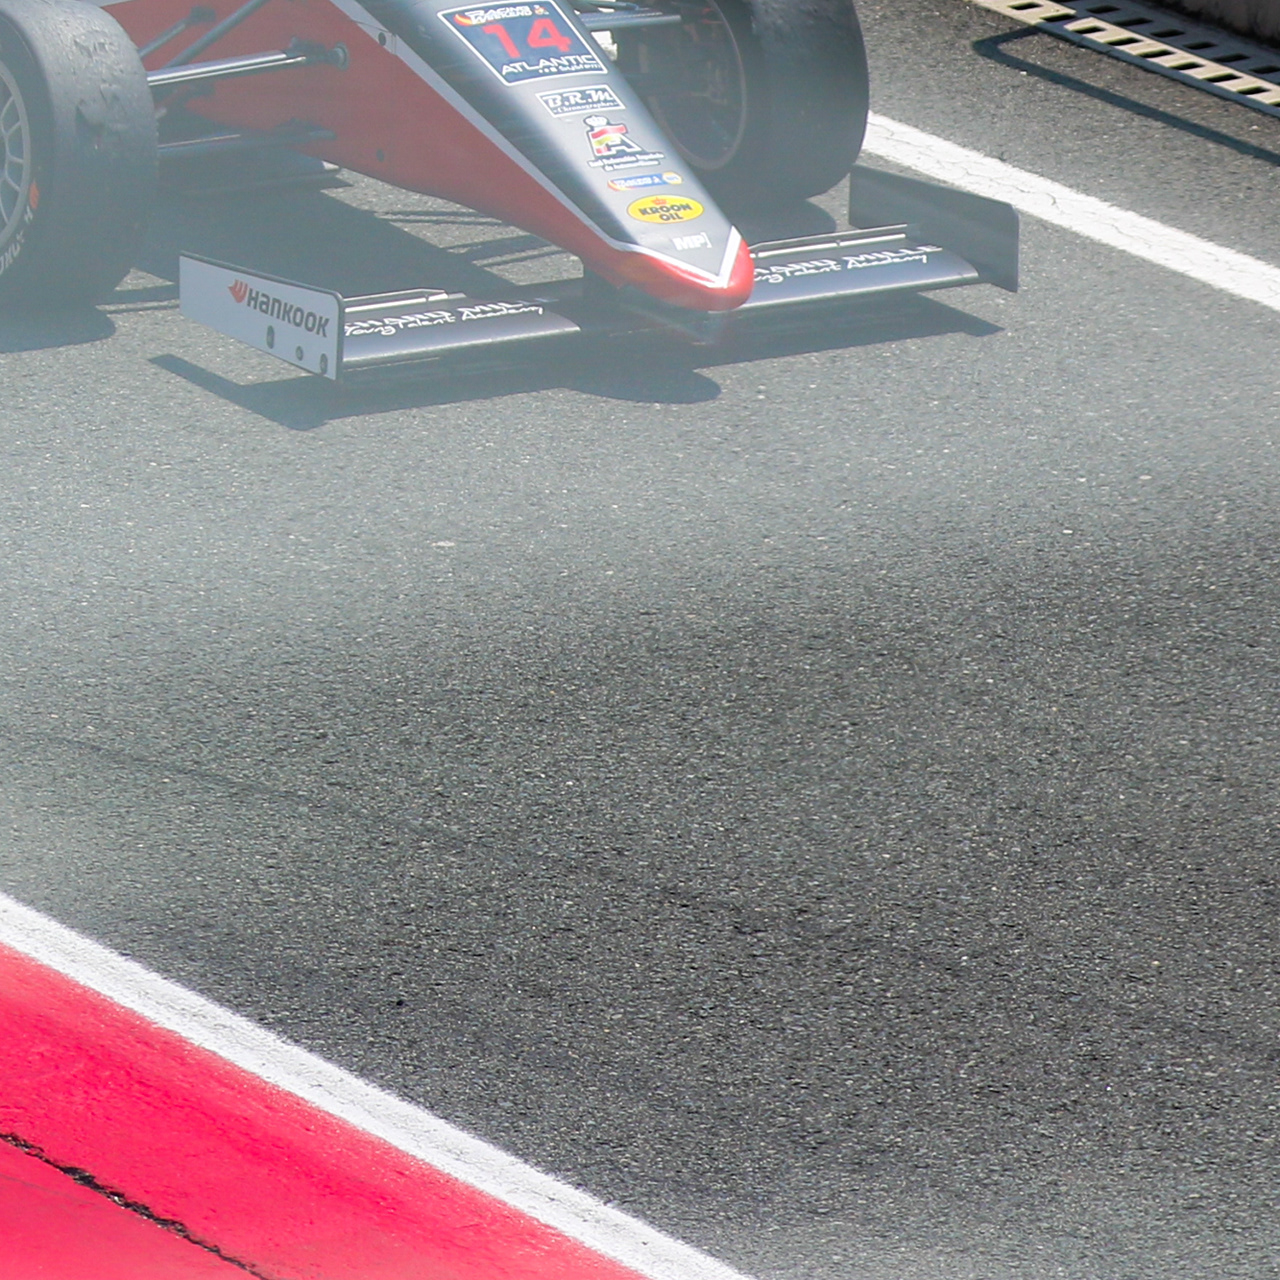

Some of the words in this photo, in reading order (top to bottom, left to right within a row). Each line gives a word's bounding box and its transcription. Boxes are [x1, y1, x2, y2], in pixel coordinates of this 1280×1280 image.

[481, 17, 573, 59] 14
[501, 54, 598, 76] ATLANTIC
[638, 202, 693, 216] KROON
[659, 213, 684, 222] OIL
